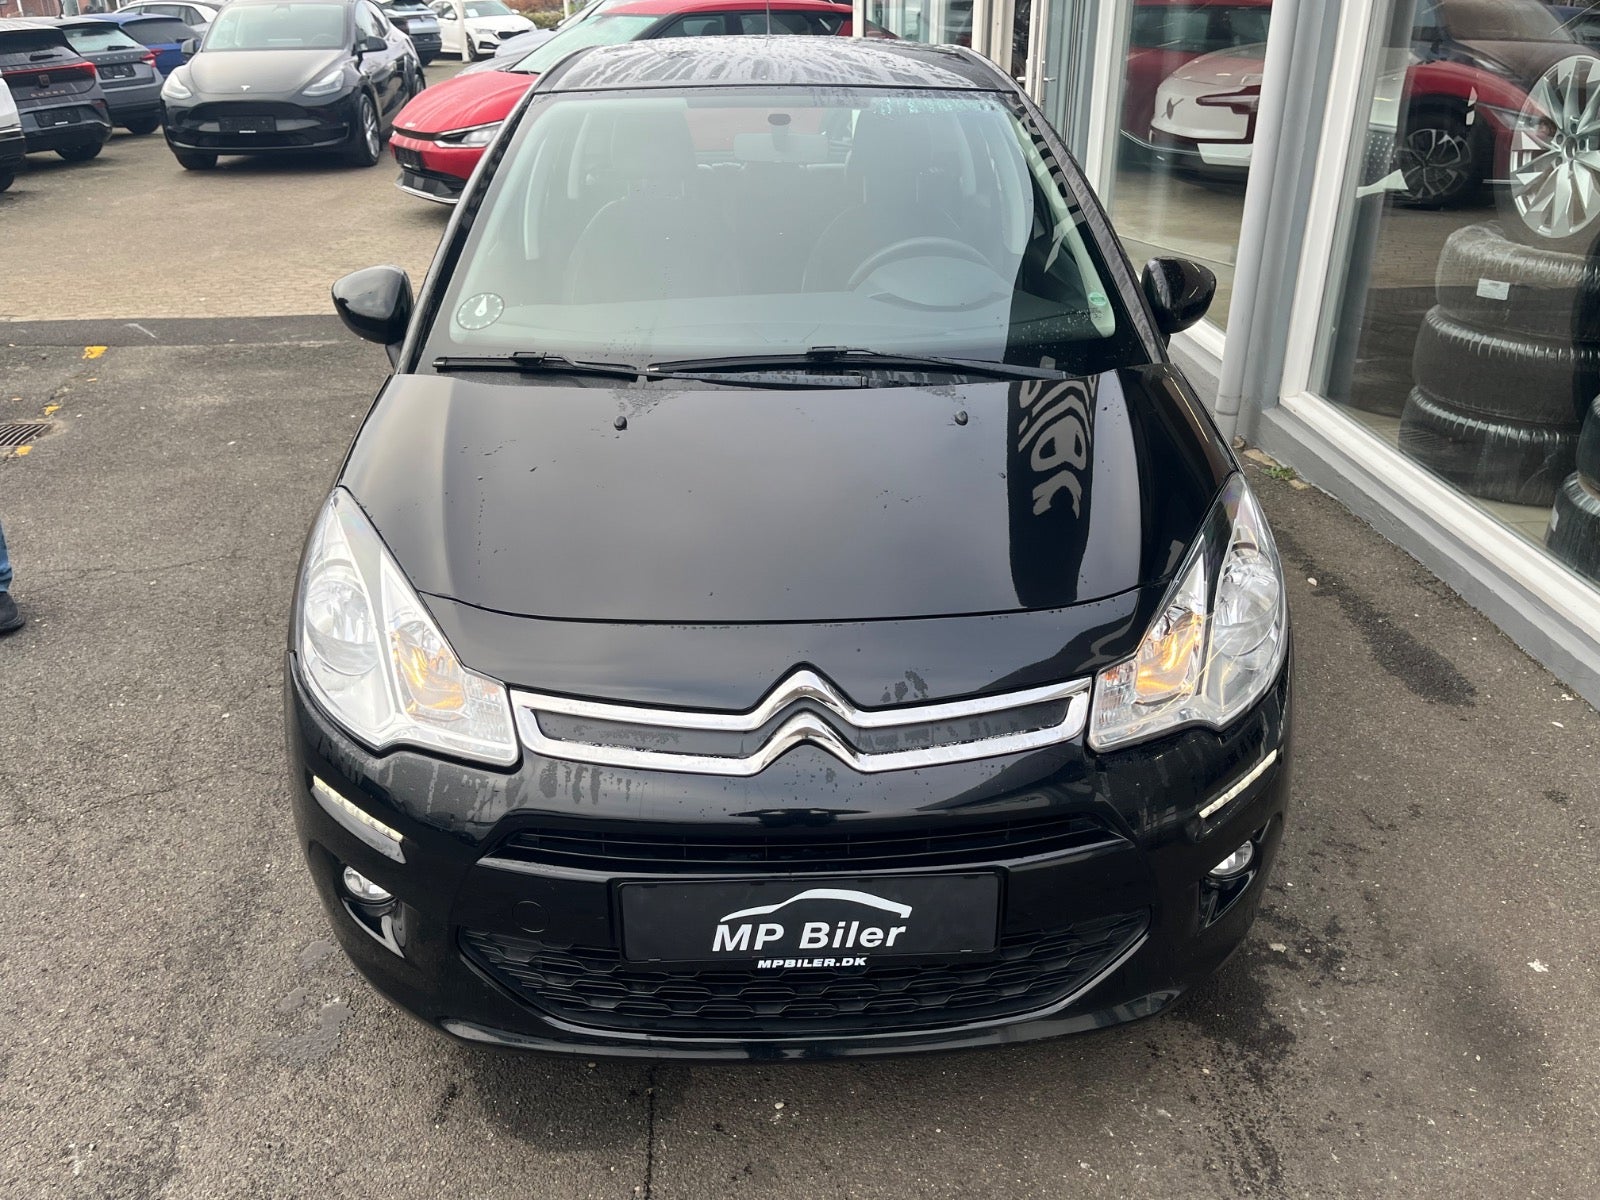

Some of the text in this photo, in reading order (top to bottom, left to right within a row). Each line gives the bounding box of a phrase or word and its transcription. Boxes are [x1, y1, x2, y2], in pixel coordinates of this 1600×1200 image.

[712, 920, 907, 952] MP Biler
[757, 956, 868, 969] MPBILER.DK
